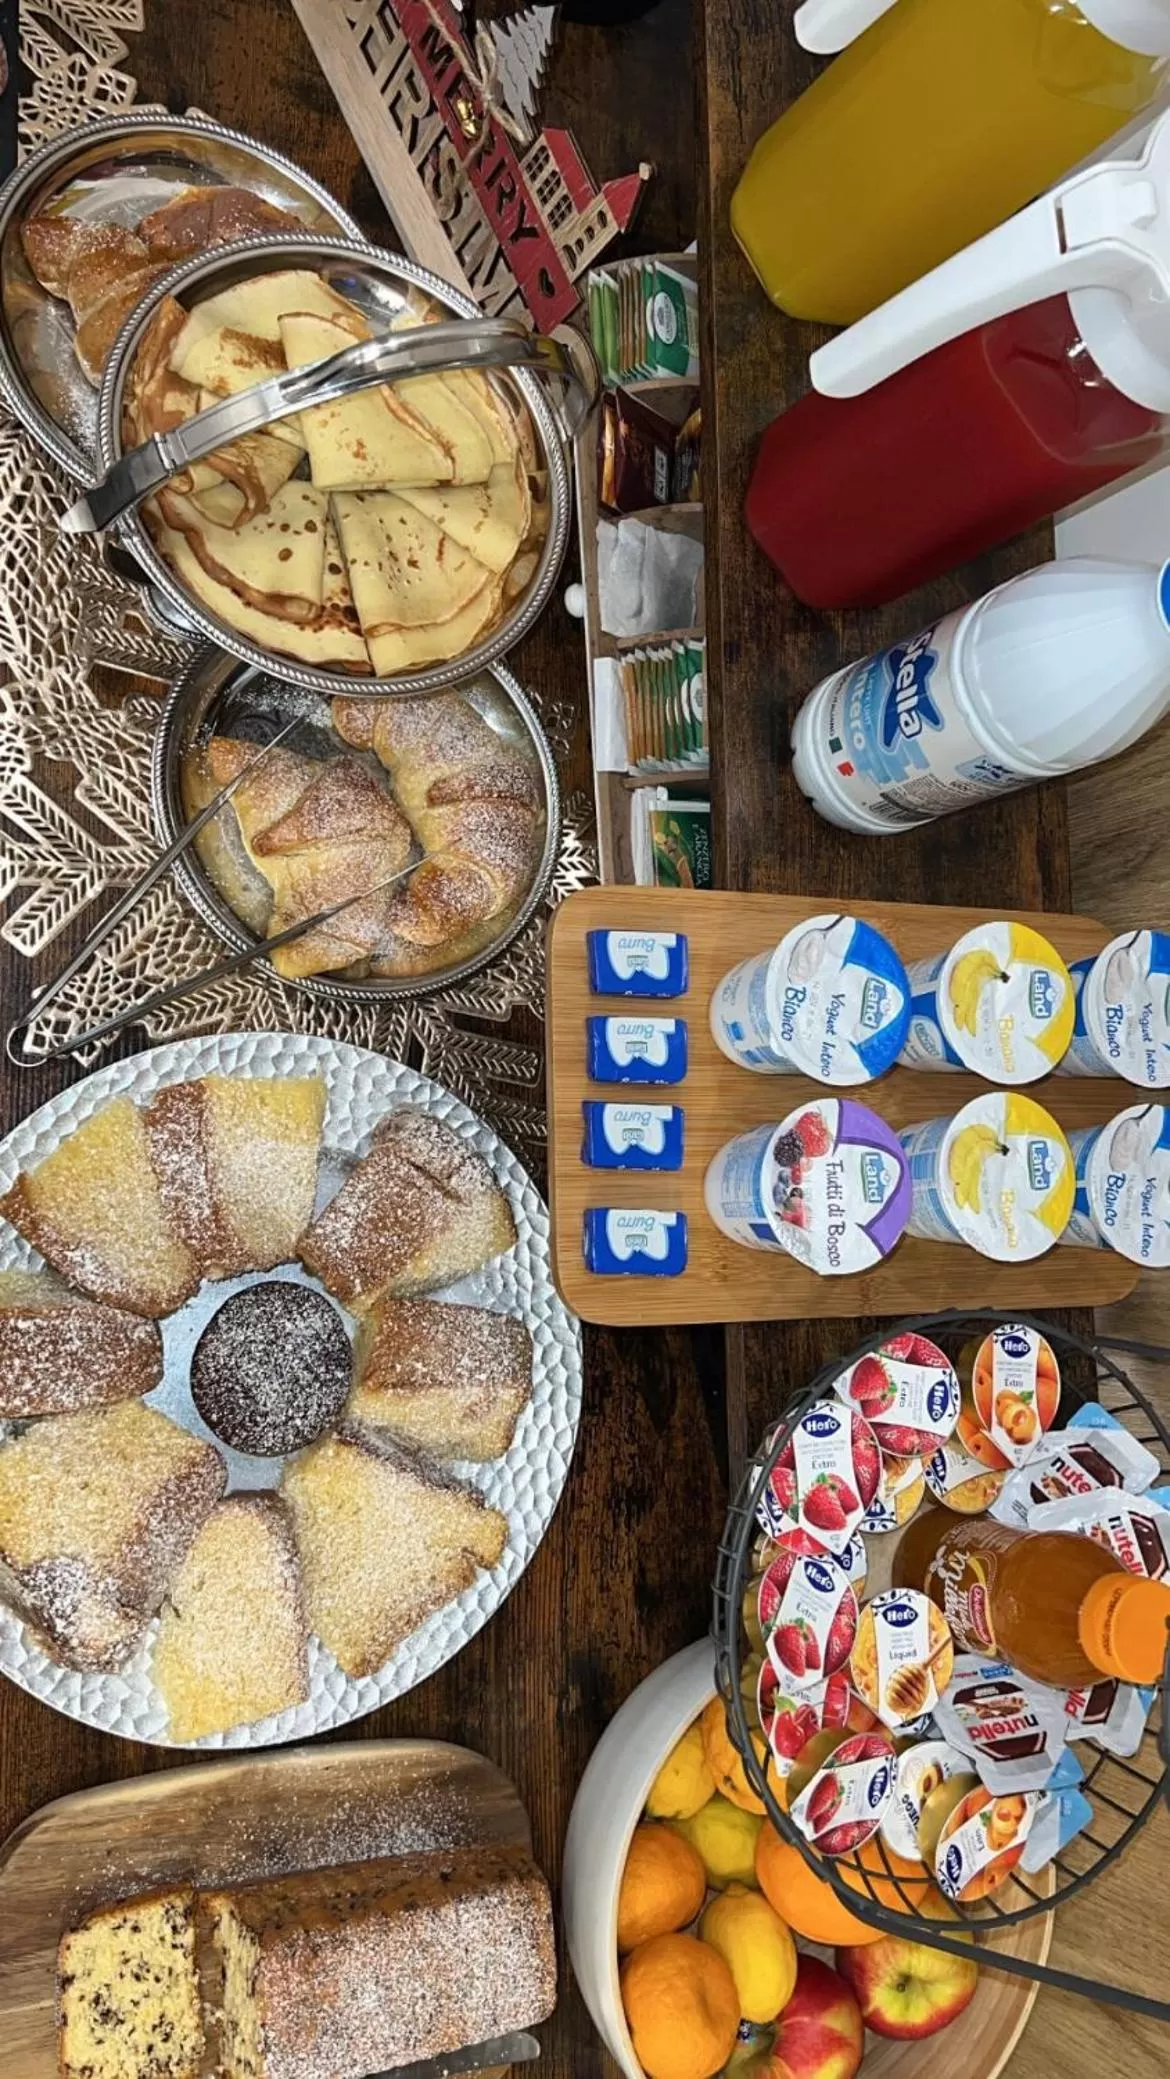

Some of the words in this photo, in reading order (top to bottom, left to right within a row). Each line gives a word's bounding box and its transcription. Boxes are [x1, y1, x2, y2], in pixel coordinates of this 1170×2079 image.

[418, 25, 541, 243] MERRY
[896, 630, 932, 739] Stella
[618, 937, 656, 953] Burro
[781, 986, 807, 1041] Bianco
[862, 978, 885, 1028] Land
[1033, 972, 1049, 1018] Land
[617, 1023, 655, 1039] Burro
[825, 993, 846, 1036] Yogurt
[1105, 1004, 1124, 1058] Bianco
[1138, 1003, 1153, 1042] Yogurt
[820, 1041, 836, 1077] Intero
[1000, 1016, 1015, 1074] Banana
[1145, 1050, 1157, 1082] Intero
[613, 1110, 652, 1126] Burro
[826, 1160, 844, 1201] Frutti
[863, 1151, 882, 1204] Land
[1032, 1142, 1049, 1190] Land
[828, 1203, 846, 1218] di
[1104, 1173, 1126, 1227] Bianco
[1139, 1177, 1157, 1217] Yogurt
[617, 1216, 655, 1232] Burro
[1000, 1191, 1017, 1248] Banana
[826, 1221, 846, 1268] Bosco
[1140, 1223, 1154, 1258] Intero
[1004, 1341, 1029, 1353] Hero
[931, 1384, 946, 1421] Hero
[806, 1417, 839, 1432] Hero
[1050, 1456, 1094, 1494] nute
[1108, 1514, 1144, 1575] nutell
[806, 1566, 834, 1590] Hero
[886, 1610, 915, 1622] Hero
[967, 1713, 1039, 1742] nutella
[871, 1773, 885, 1807] Hero
[901, 1793, 919, 1831] UEGG
[950, 1848, 961, 1883] Hero
